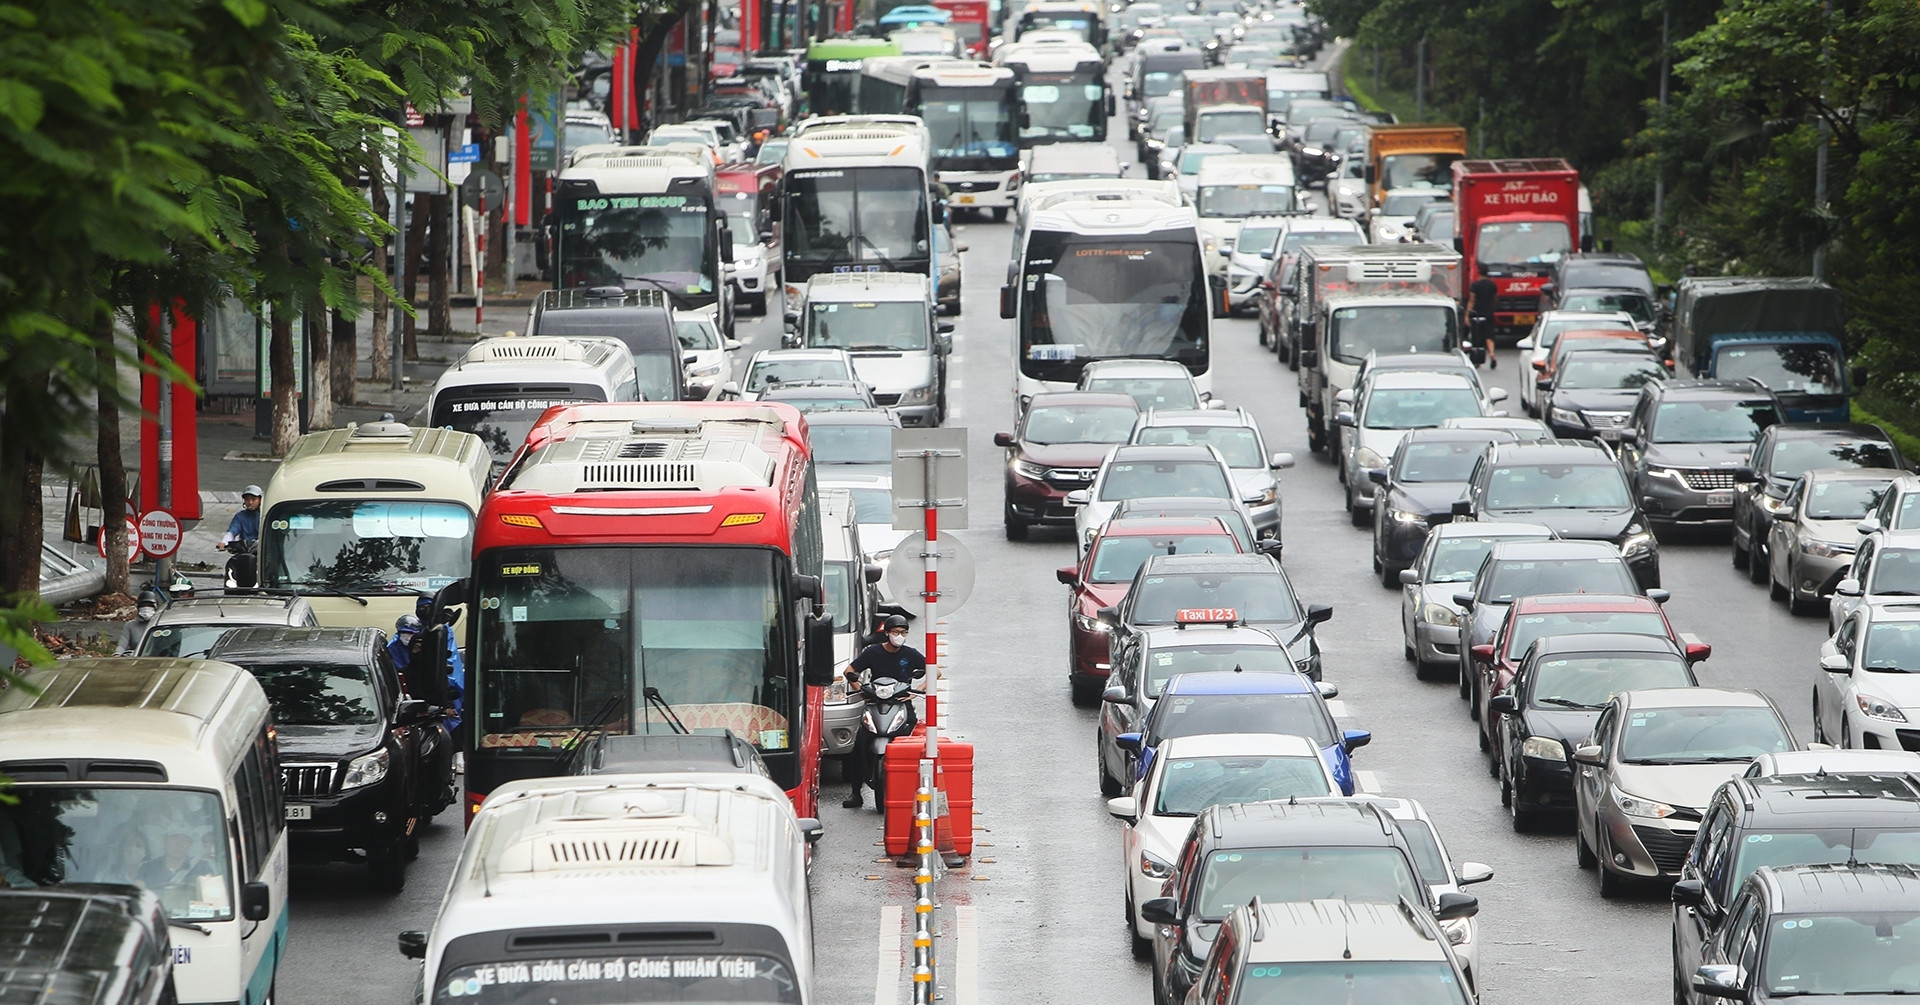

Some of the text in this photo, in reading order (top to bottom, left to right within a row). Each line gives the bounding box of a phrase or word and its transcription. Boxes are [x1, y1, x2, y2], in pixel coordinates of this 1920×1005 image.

[1484, 189, 1558, 204] XE THƯ BÁO
[577, 197, 686, 211] BAO YEN GROUP
[1076, 249, 1104, 257] LOTTE
[453, 404, 462, 412] XE
[464, 403, 479, 411] ĐƯA
[481, 401, 496, 410] ĐÓN
[498, 400, 514, 410] CÁN
[515, 400, 525, 411] BỘ
[527, 400, 548, 410] CÔNG
[164, 533, 177, 541] CÔNG
[1181, 609, 1233, 620] Taxi 123
[171, 944, 191, 964] IÊN
[475, 967, 495, 985] XE
[498, 964, 530, 984] ĐƯA
[604, 957, 625, 982] BỘ
[628, 957, 670, 978] CÔNG
[673, 957, 718, 978] NHÂN
[720, 957, 756, 978] VIÊN
